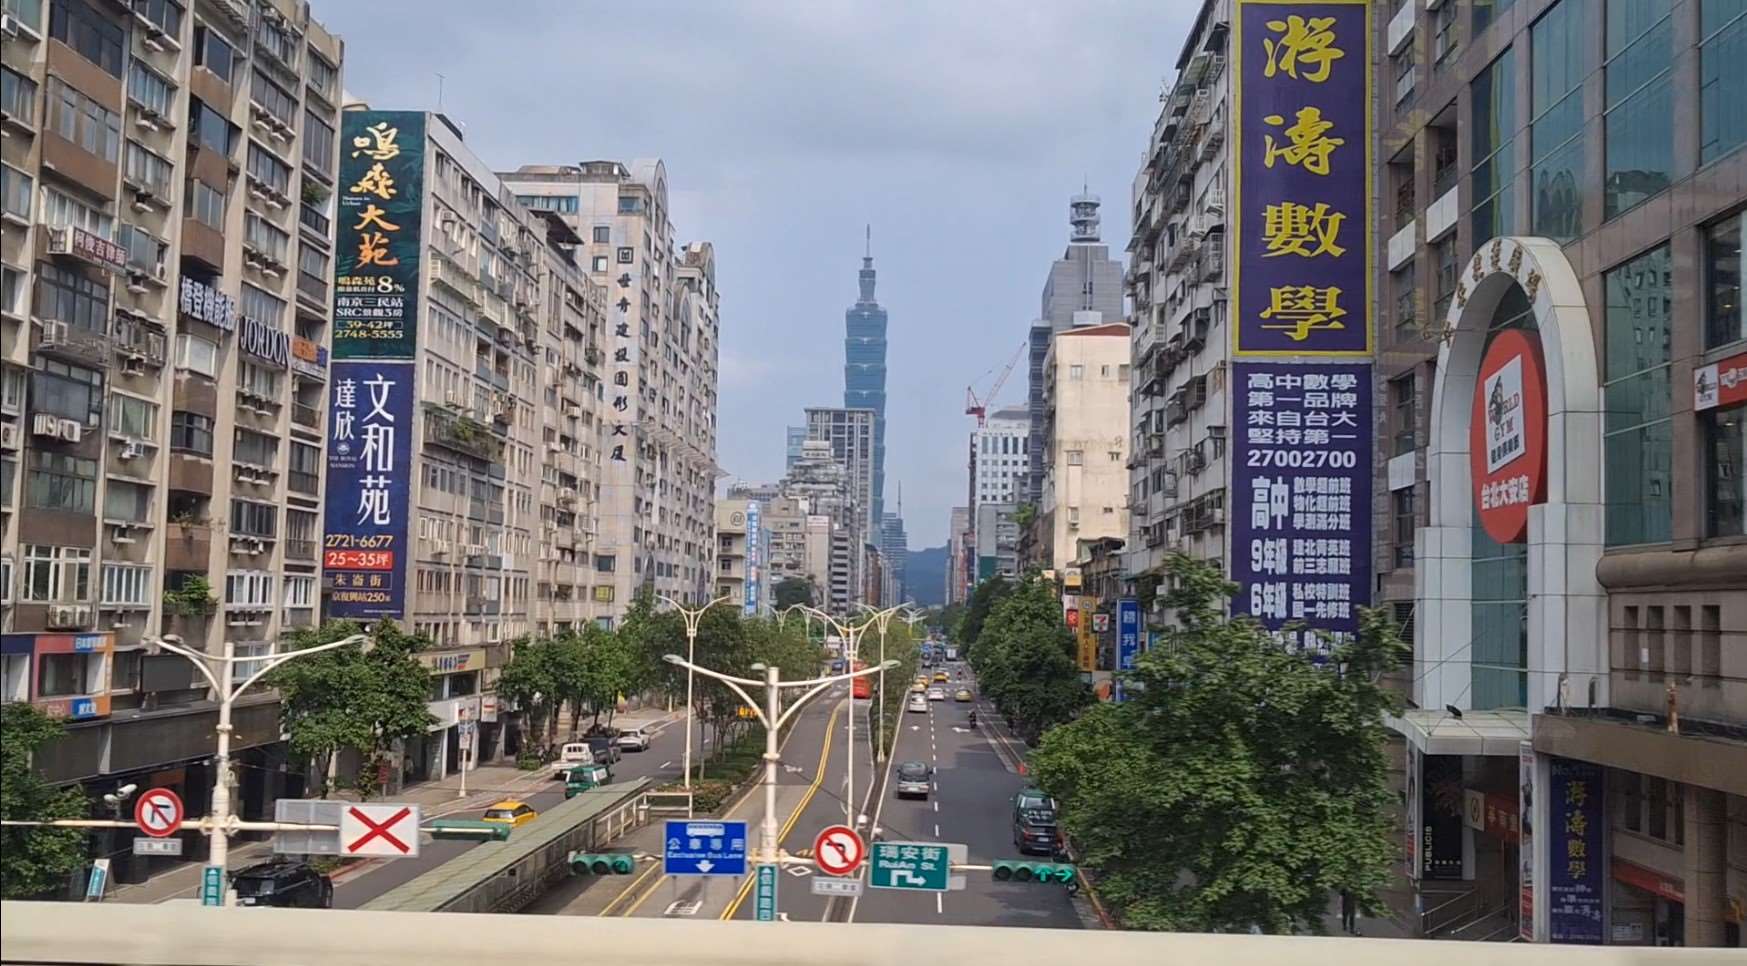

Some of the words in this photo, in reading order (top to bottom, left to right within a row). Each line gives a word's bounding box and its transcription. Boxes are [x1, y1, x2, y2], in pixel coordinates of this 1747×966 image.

[240, 315, 290, 368] JORDON
[1248, 373, 1358, 390] 高中數學
[1248, 391, 1358, 408] 第一品牌
[334, 378, 356, 441] 達欣
[1247, 410, 1358, 427] 來自台大
[1247, 428, 1358, 445] 堅持第一
[357, 373, 396, 526] 文和苑
[1247, 449, 1357, 468] 27002700
[1251, 475, 1289, 531] 高中
[325, 533, 394, 549] 2721-6677
[1251, 538, 1288, 576] 9年級
[1250, 581, 1287, 619] 6年級
[879, 845, 940, 861] 瑞安街
